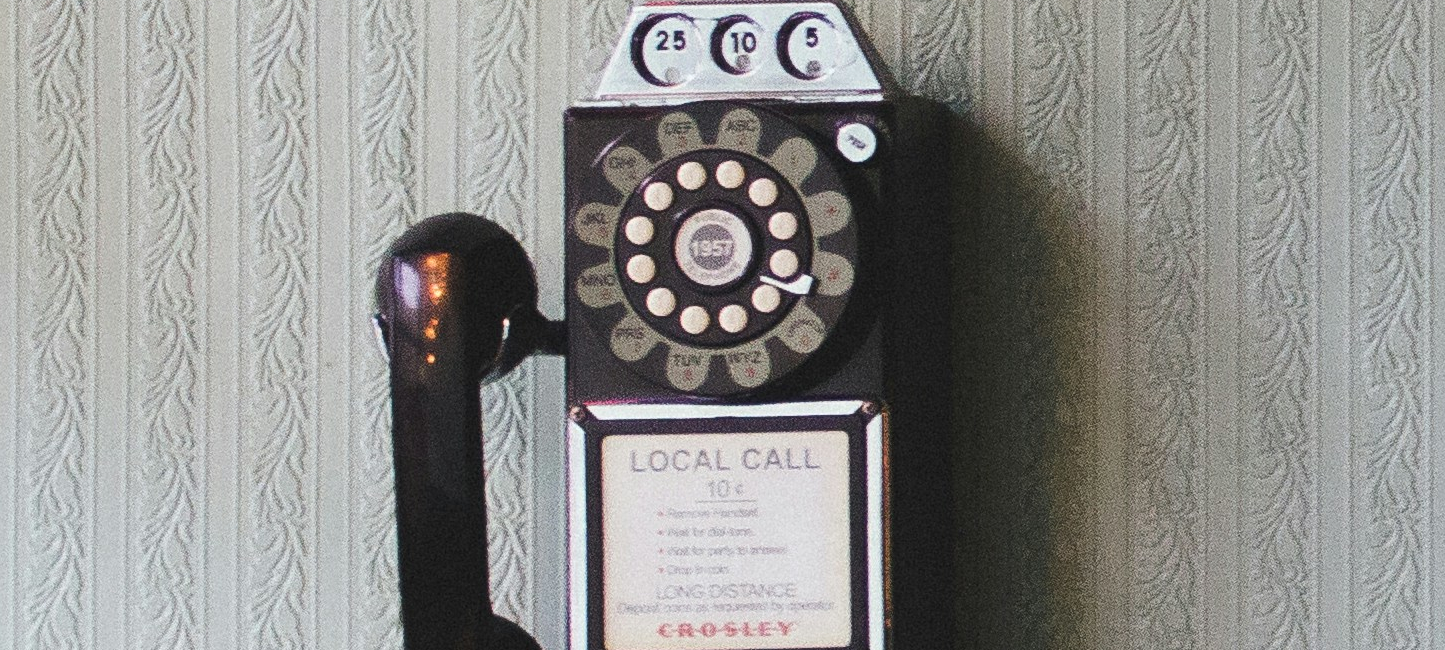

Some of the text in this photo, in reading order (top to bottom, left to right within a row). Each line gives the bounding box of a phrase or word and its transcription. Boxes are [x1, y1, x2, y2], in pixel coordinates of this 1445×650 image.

[656, 30, 686, 51] 25
[731, 32, 757, 54] 10
[805, 27, 819, 48] 5
[665, 121, 691, 135] DEF
[725, 119, 757, 133] ABC
[608, 157, 635, 169] GHI
[690, 239, 733, 258] 1957
[582, 275, 614, 287] MNO
[673, 354, 703, 367] TUV
[631, 448, 821, 472] LOCAL CALL
[708, 479, 730, 498] 10
[667, 507, 710, 519] Remove
[667, 527, 689, 537] Wait
[692, 526, 705, 537] for
[667, 546, 689, 556] Wait
[691, 545, 705, 556] for
[708, 545, 735, 557] party
[737, 546, 748, 556] to
[666, 564, 693, 575] Drop
[656, 582, 797, 600] LONG DISTANCE
[617, 602, 660, 615] Deposit
[696, 604, 711, 613] as
[712, 602, 767, 614] requested
[771, 602, 783, 614] by
[657, 621, 793, 638] CROSLEY
